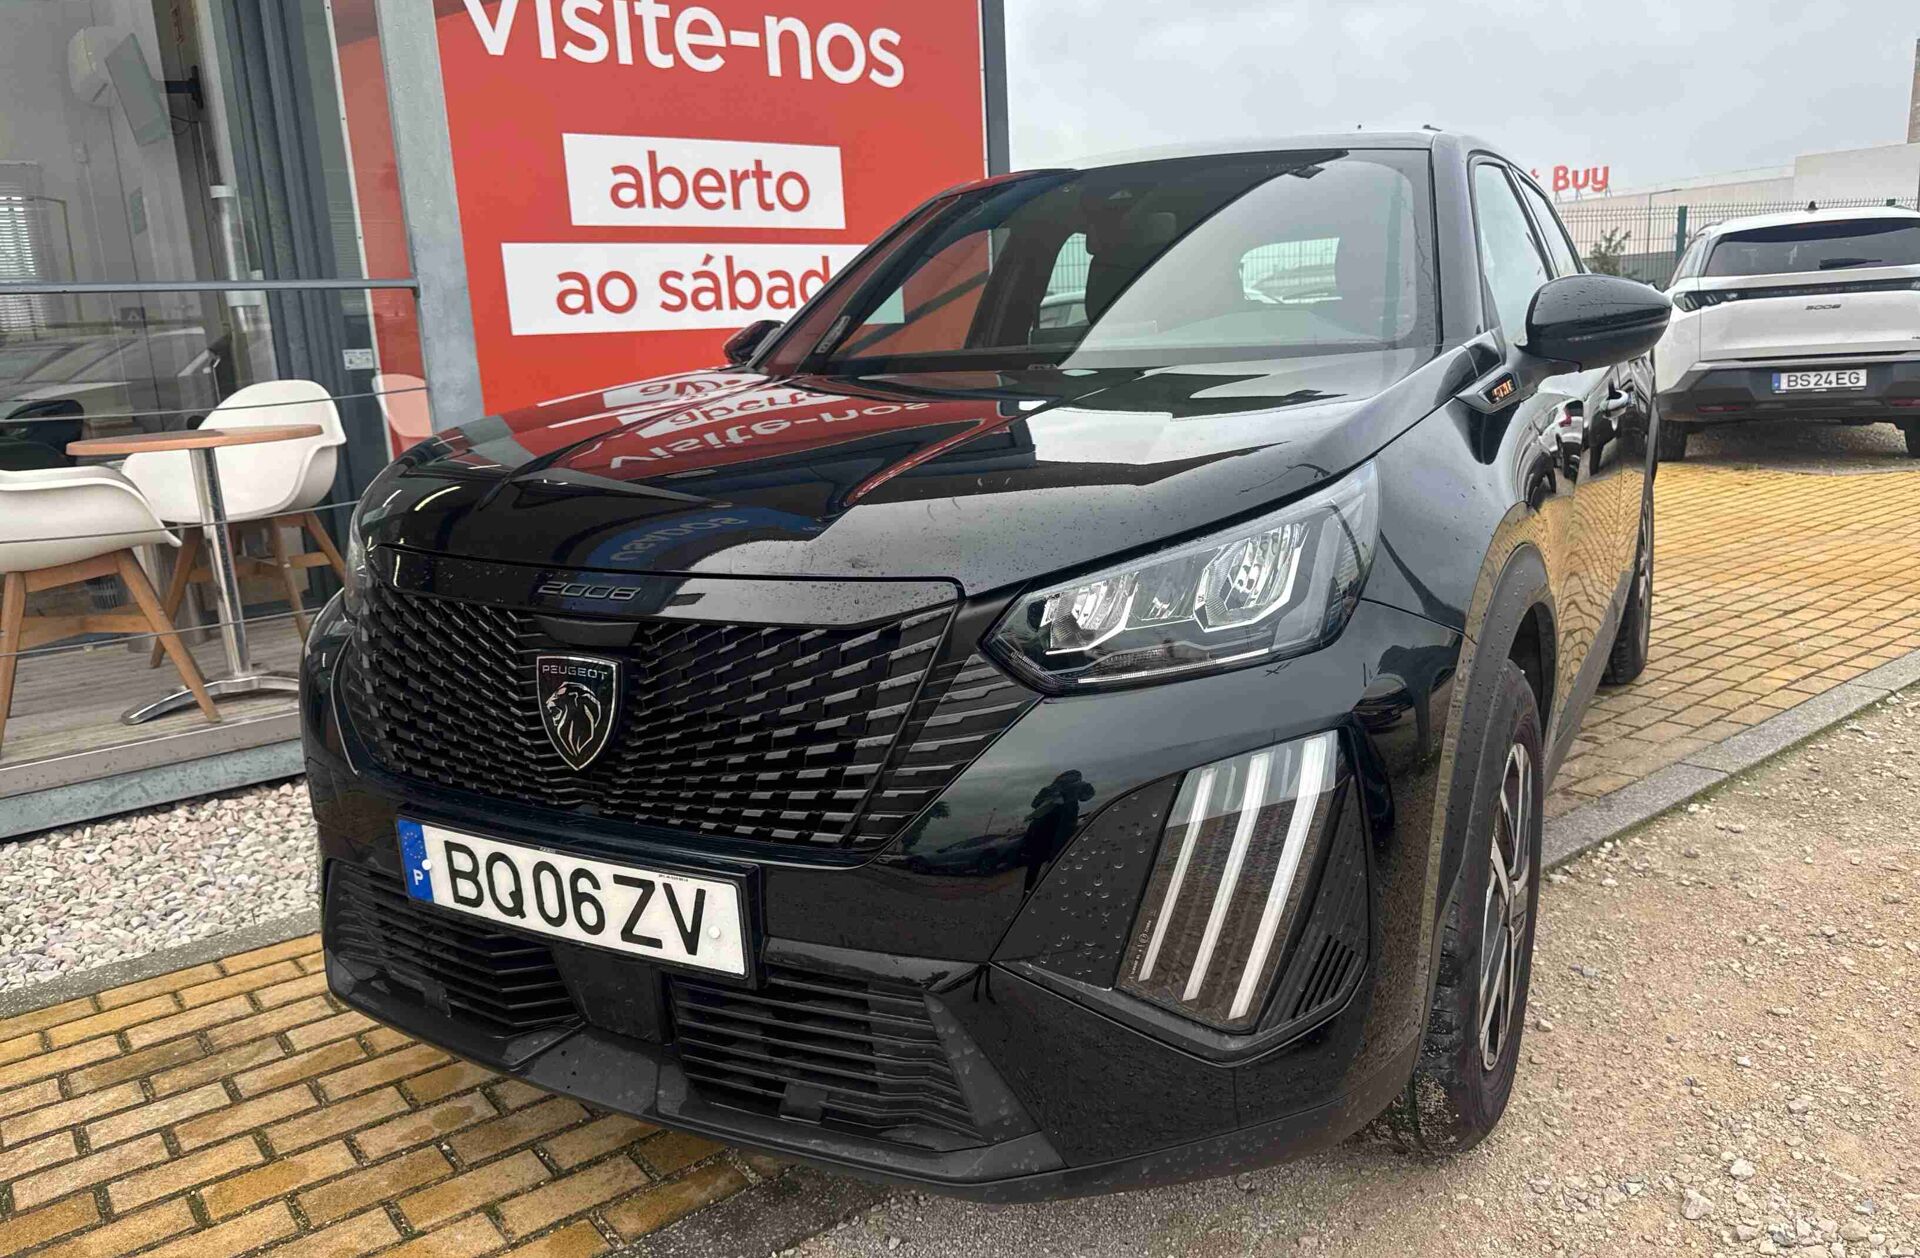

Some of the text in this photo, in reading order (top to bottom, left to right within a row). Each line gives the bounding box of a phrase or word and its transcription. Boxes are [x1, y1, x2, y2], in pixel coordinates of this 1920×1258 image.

[609, 150, 811, 212] aberto
[1552, 165, 1609, 192] Buy
[556, 254, 832, 316] ao sábad
[1786, 371, 1861, 388] BS24EG
[537, 580, 642, 600] 2008
[541, 664, 608, 680] PEUGEOT
[412, 870, 424, 887] P
[443, 839, 707, 957] BQ06ZV
